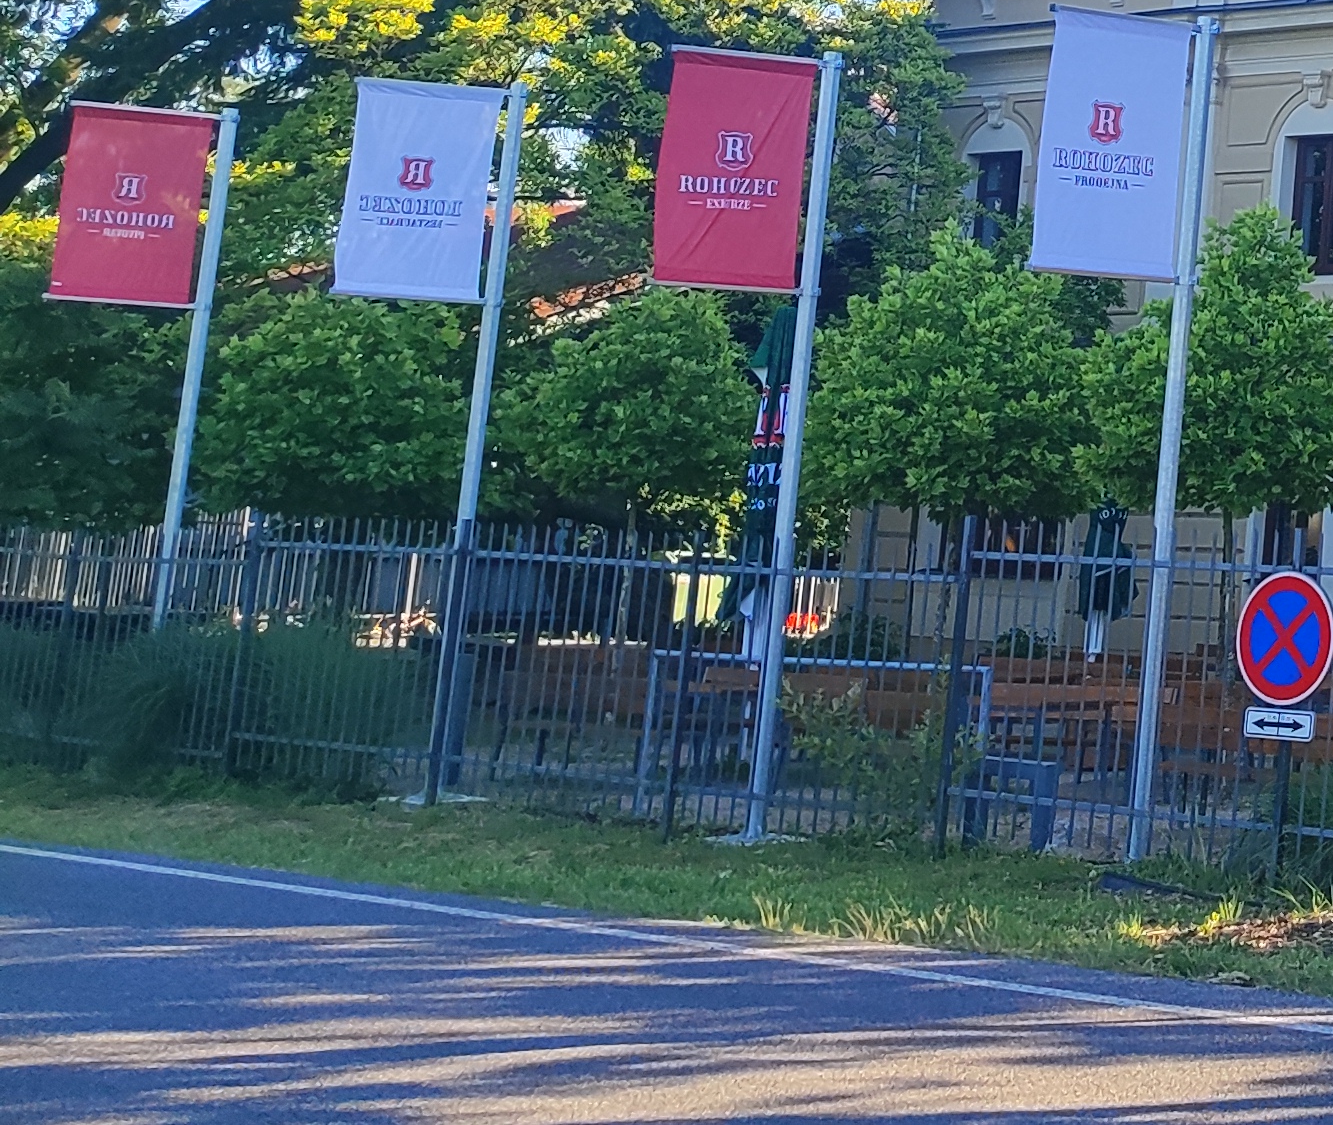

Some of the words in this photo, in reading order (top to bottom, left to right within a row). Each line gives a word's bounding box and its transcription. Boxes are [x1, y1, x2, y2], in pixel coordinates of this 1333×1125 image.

[1094, 106, 1117, 135] R
[723, 136, 746, 162] R
[1053, 147, 1154, 177] ROHOZEC
[678, 174, 779, 197] ROHOZEC
